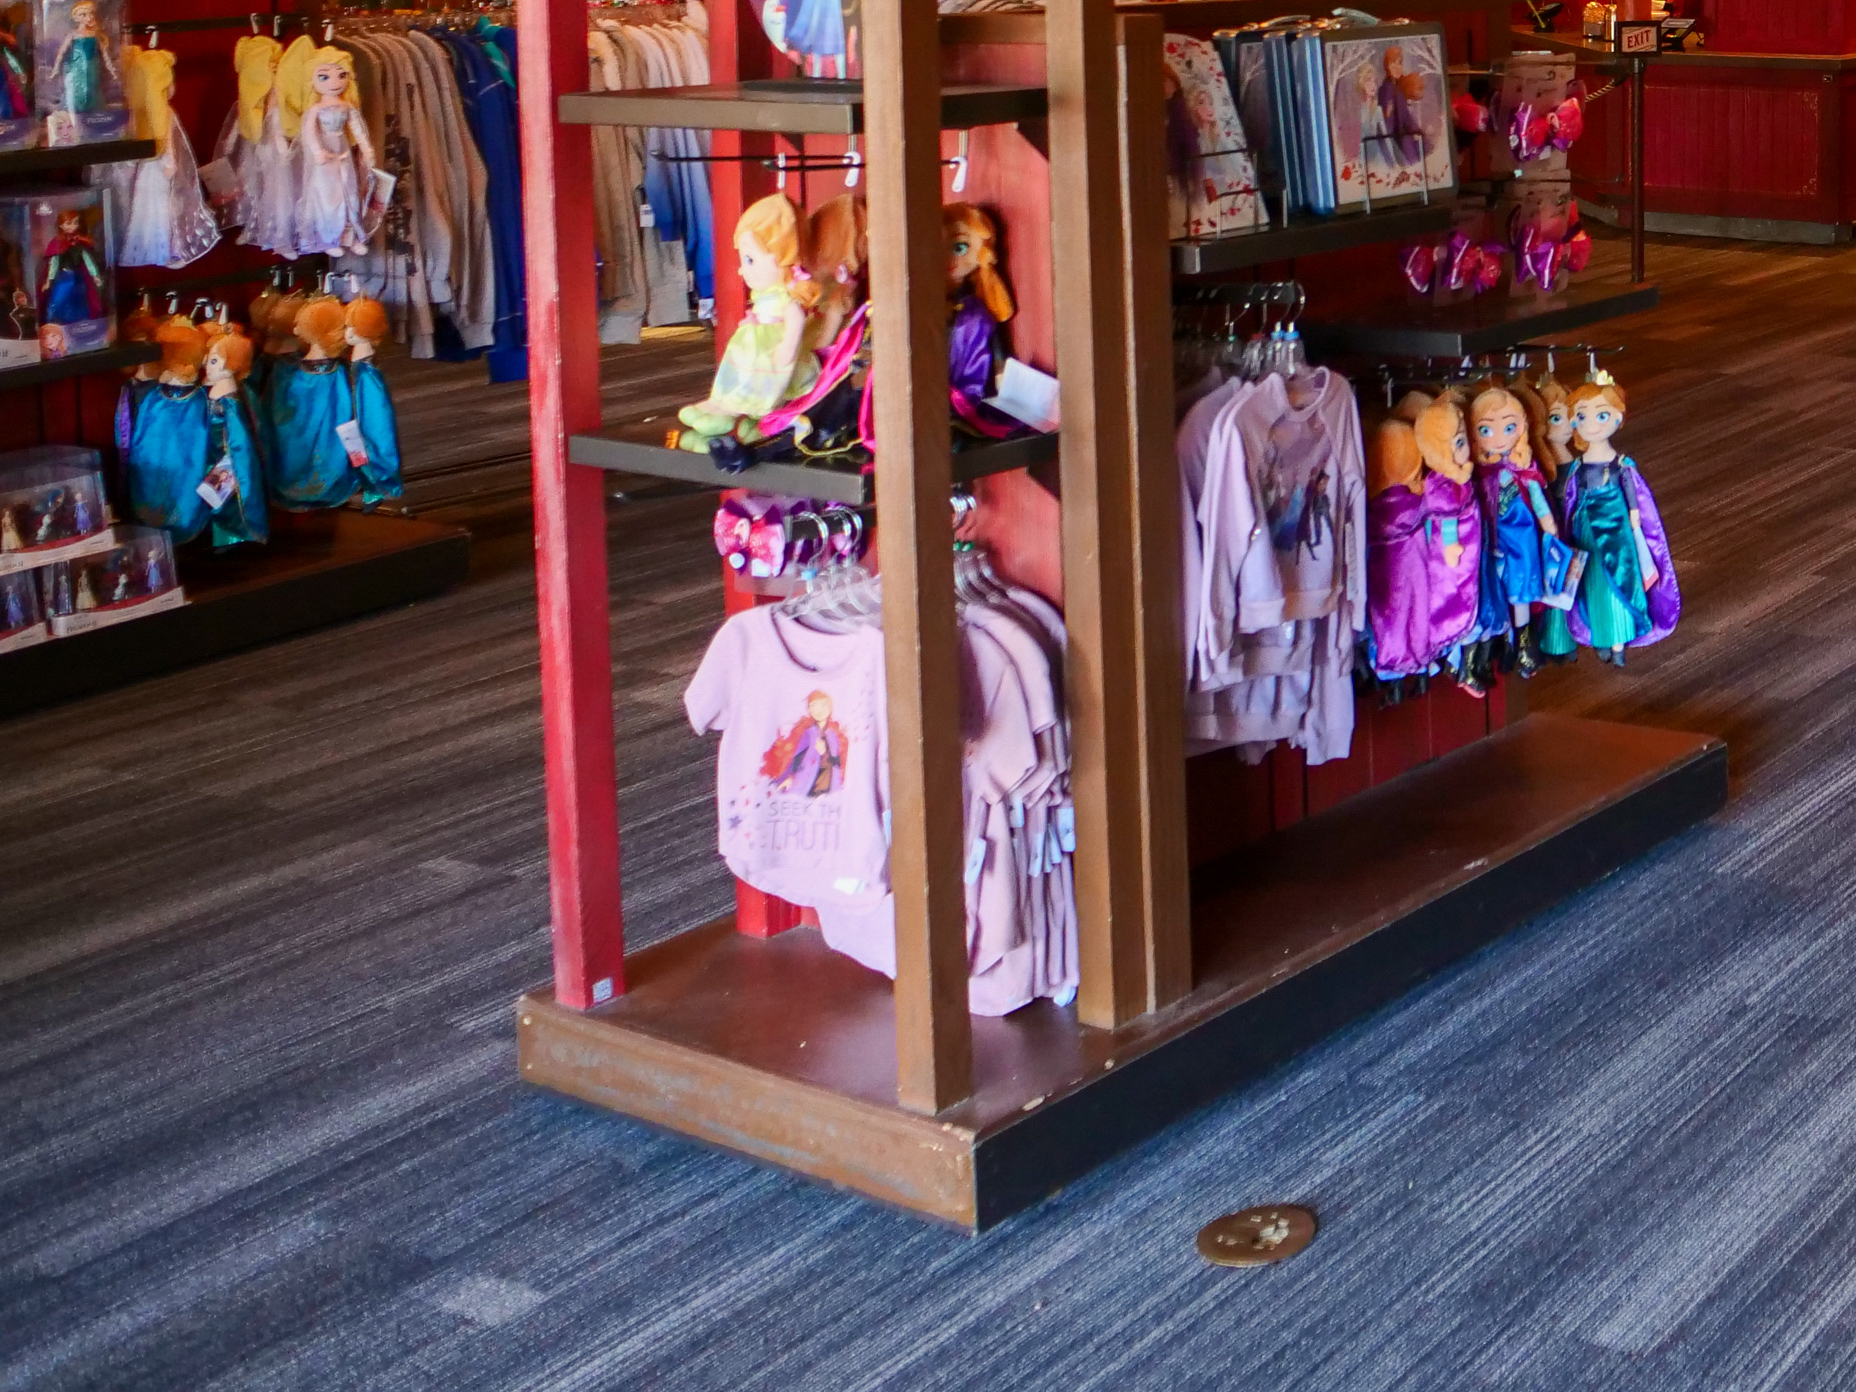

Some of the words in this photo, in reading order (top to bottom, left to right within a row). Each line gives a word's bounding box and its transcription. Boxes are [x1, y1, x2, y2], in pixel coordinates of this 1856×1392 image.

[1627, 29, 1651, 49] EXIT
[768, 801, 813, 817] SEEK
[819, 804, 841, 819] TH
